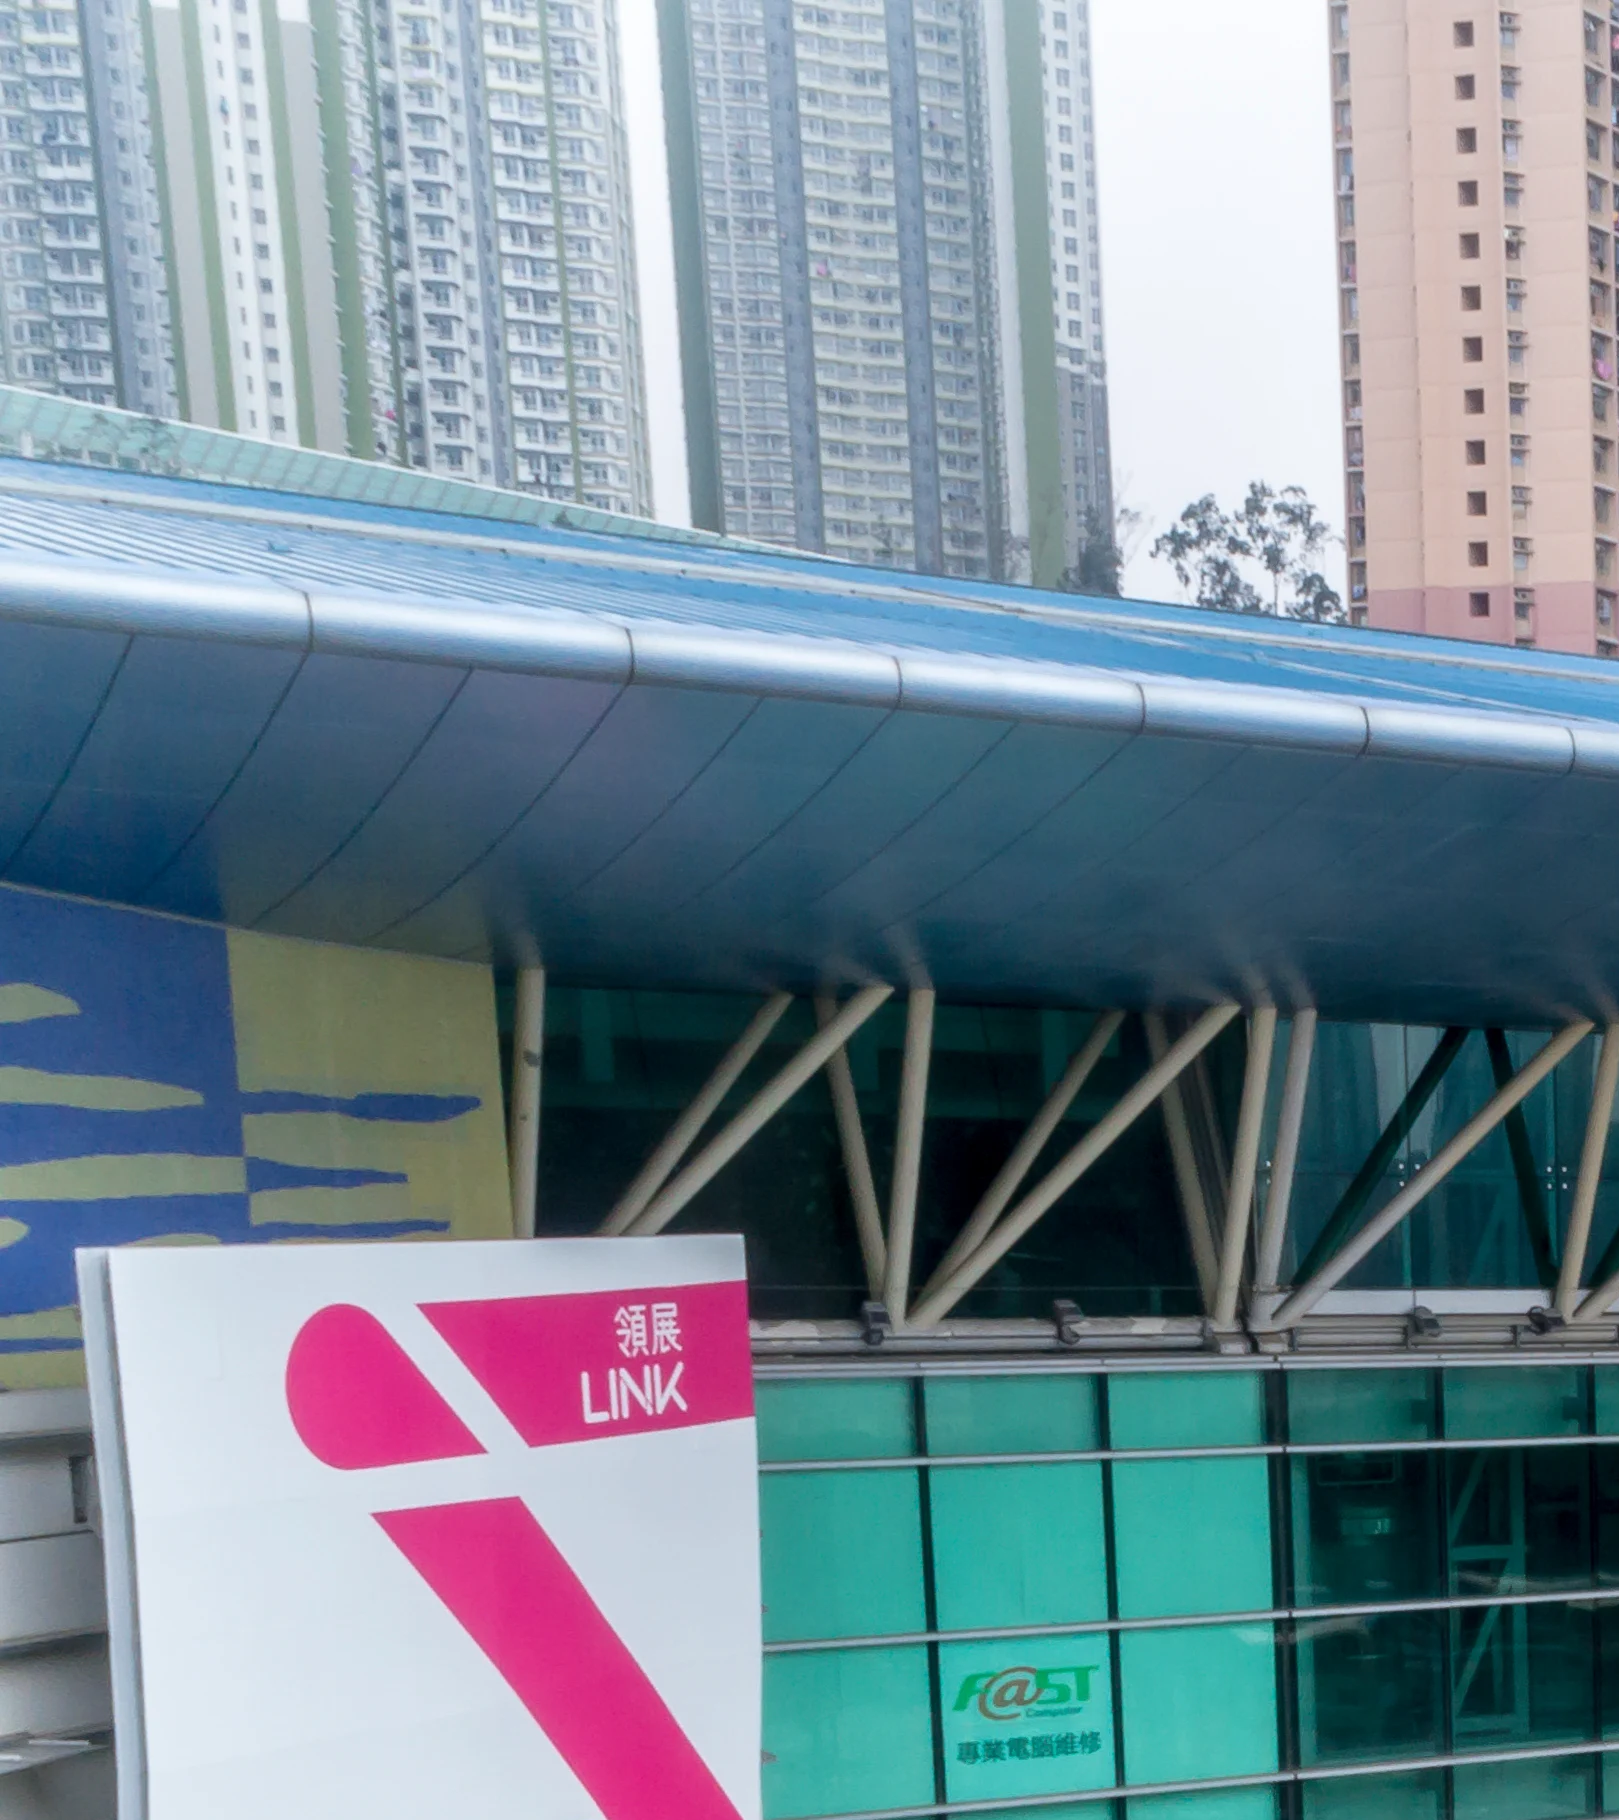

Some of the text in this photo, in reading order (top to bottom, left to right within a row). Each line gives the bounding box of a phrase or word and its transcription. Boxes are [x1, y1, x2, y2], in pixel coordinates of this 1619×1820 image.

[614, 1302, 682, 1357] 領展
[582, 1363, 688, 1424] LINK
[956, 1730, 1101, 1765] 專業電腦維修
